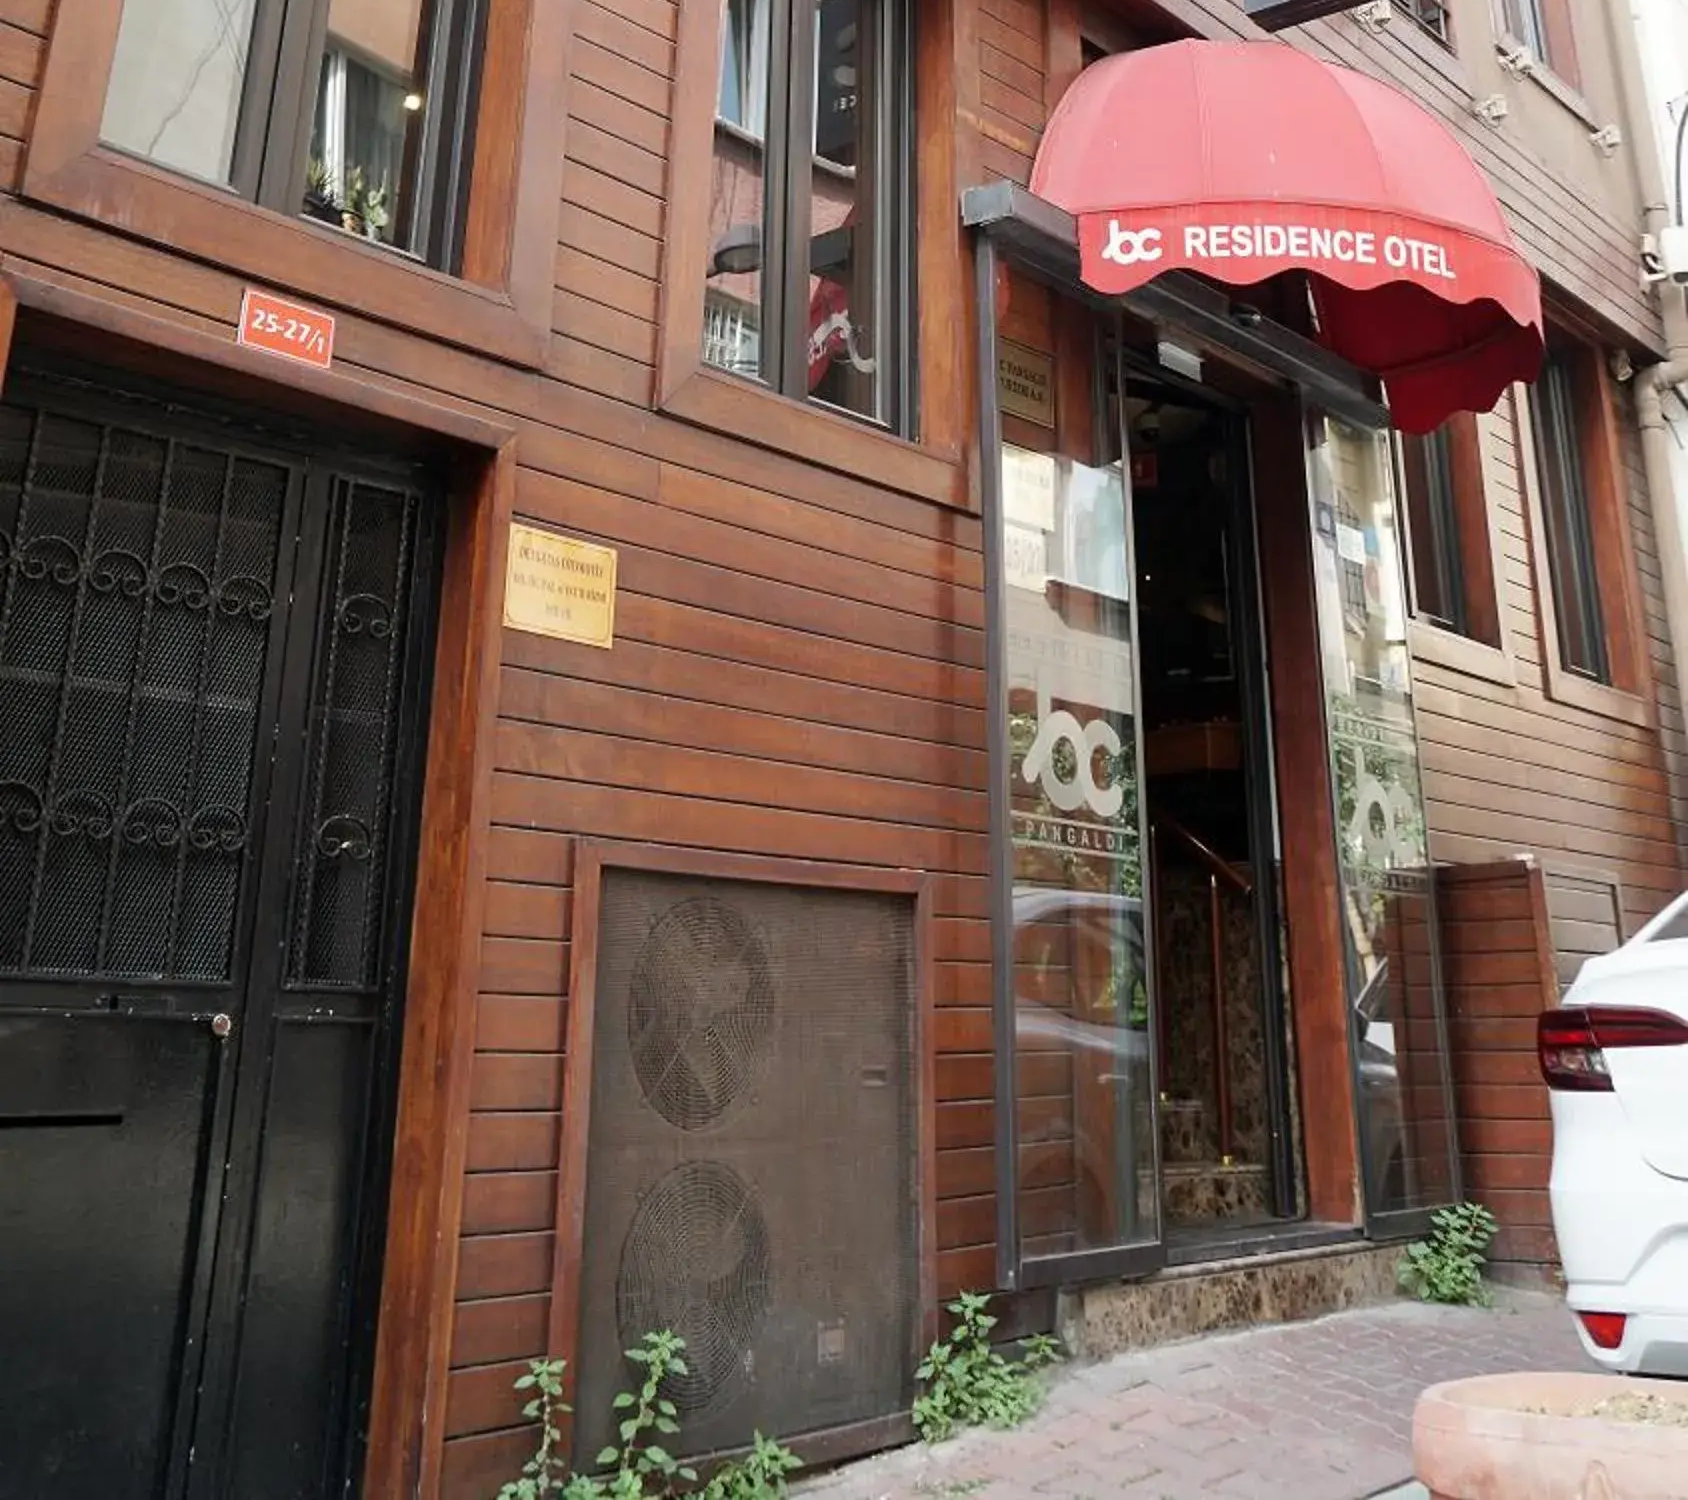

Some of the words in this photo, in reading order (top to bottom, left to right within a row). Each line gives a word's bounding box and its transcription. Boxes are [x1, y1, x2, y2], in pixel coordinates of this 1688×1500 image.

[1184, 225, 1377, 264] RESIDENCE
[1383, 235, 1457, 279] OTEL
[251, 308, 325, 354] 25-27/1
[1024, 820, 1125, 850] PANGALDI
